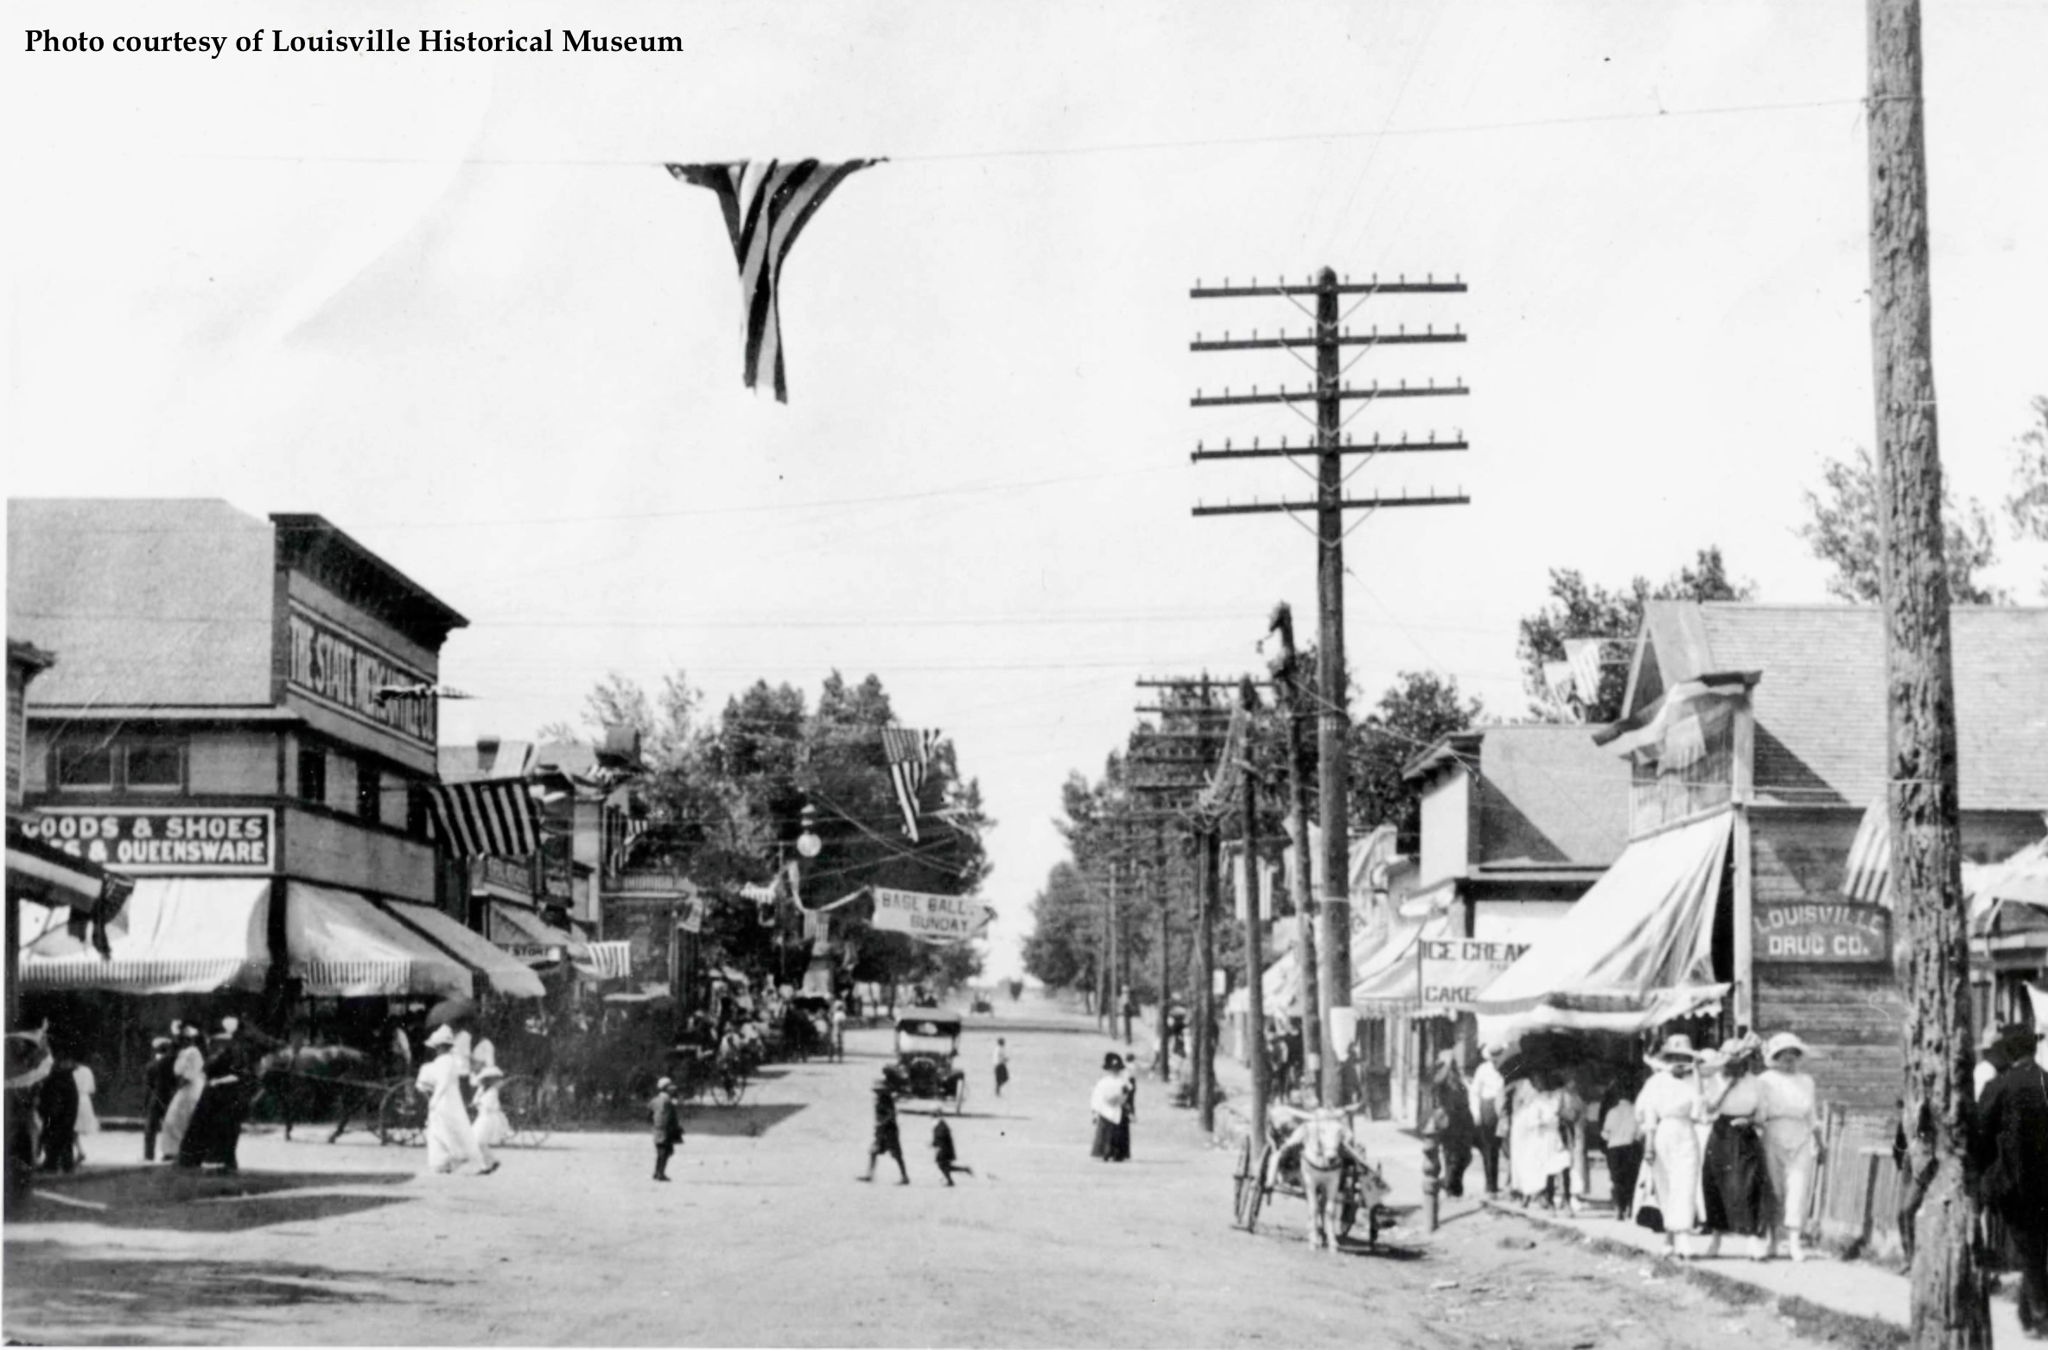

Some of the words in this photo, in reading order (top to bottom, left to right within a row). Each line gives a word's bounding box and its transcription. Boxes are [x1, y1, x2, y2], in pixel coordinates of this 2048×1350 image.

[132, 817, 153, 839] &
[166, 817, 263, 839] SHOES
[88, 839, 109, 862] &
[117, 839, 266, 863] QUEENSWARE
[882, 892, 920, 912] BASE
[910, 914, 970, 932] SUNDAY
[1754, 905, 1884, 936] LOUISVILLE
[1421, 941, 1456, 961] ICE
[1769, 935, 1825, 956] DRUG
[1833, 935, 1871, 956] CO.
